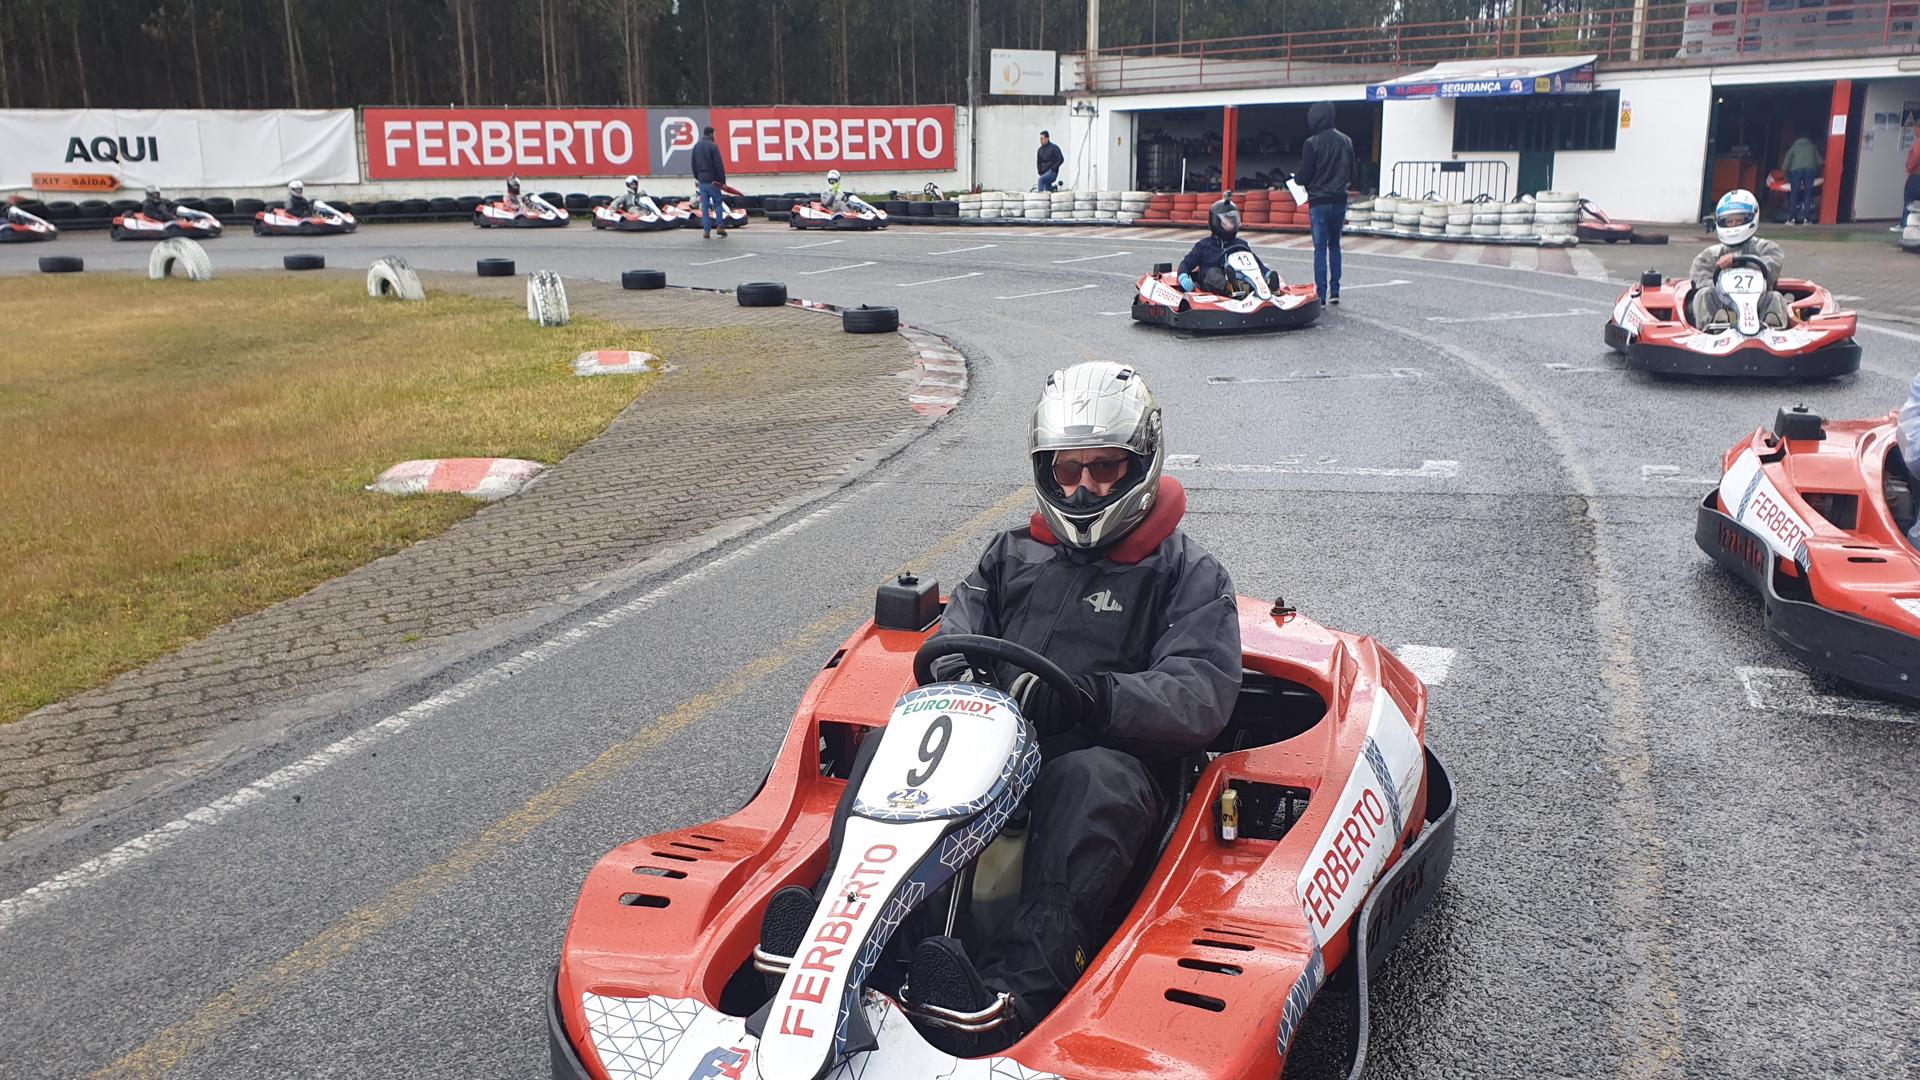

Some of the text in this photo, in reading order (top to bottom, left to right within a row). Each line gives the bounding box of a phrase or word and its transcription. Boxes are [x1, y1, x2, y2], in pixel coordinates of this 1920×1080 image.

[1441, 82, 1500, 94] SEGURANÇA
[64, 136, 159, 164] AQUI
[384, 119, 633, 167] FERBERTO
[728, 117, 943, 163] FERBERTO
[34, 177, 60, 185] EXIT
[72, 177, 107, 186] SAÍDA
[1238, 255, 1251, 266] 13
[1734, 275, 1754, 288] 27
[903, 699, 997, 716] EUROINDY
[906, 715, 953, 787] 9
[1302, 788, 1385, 929] ERBERTO
[780, 843, 898, 1039] FERBERTO
